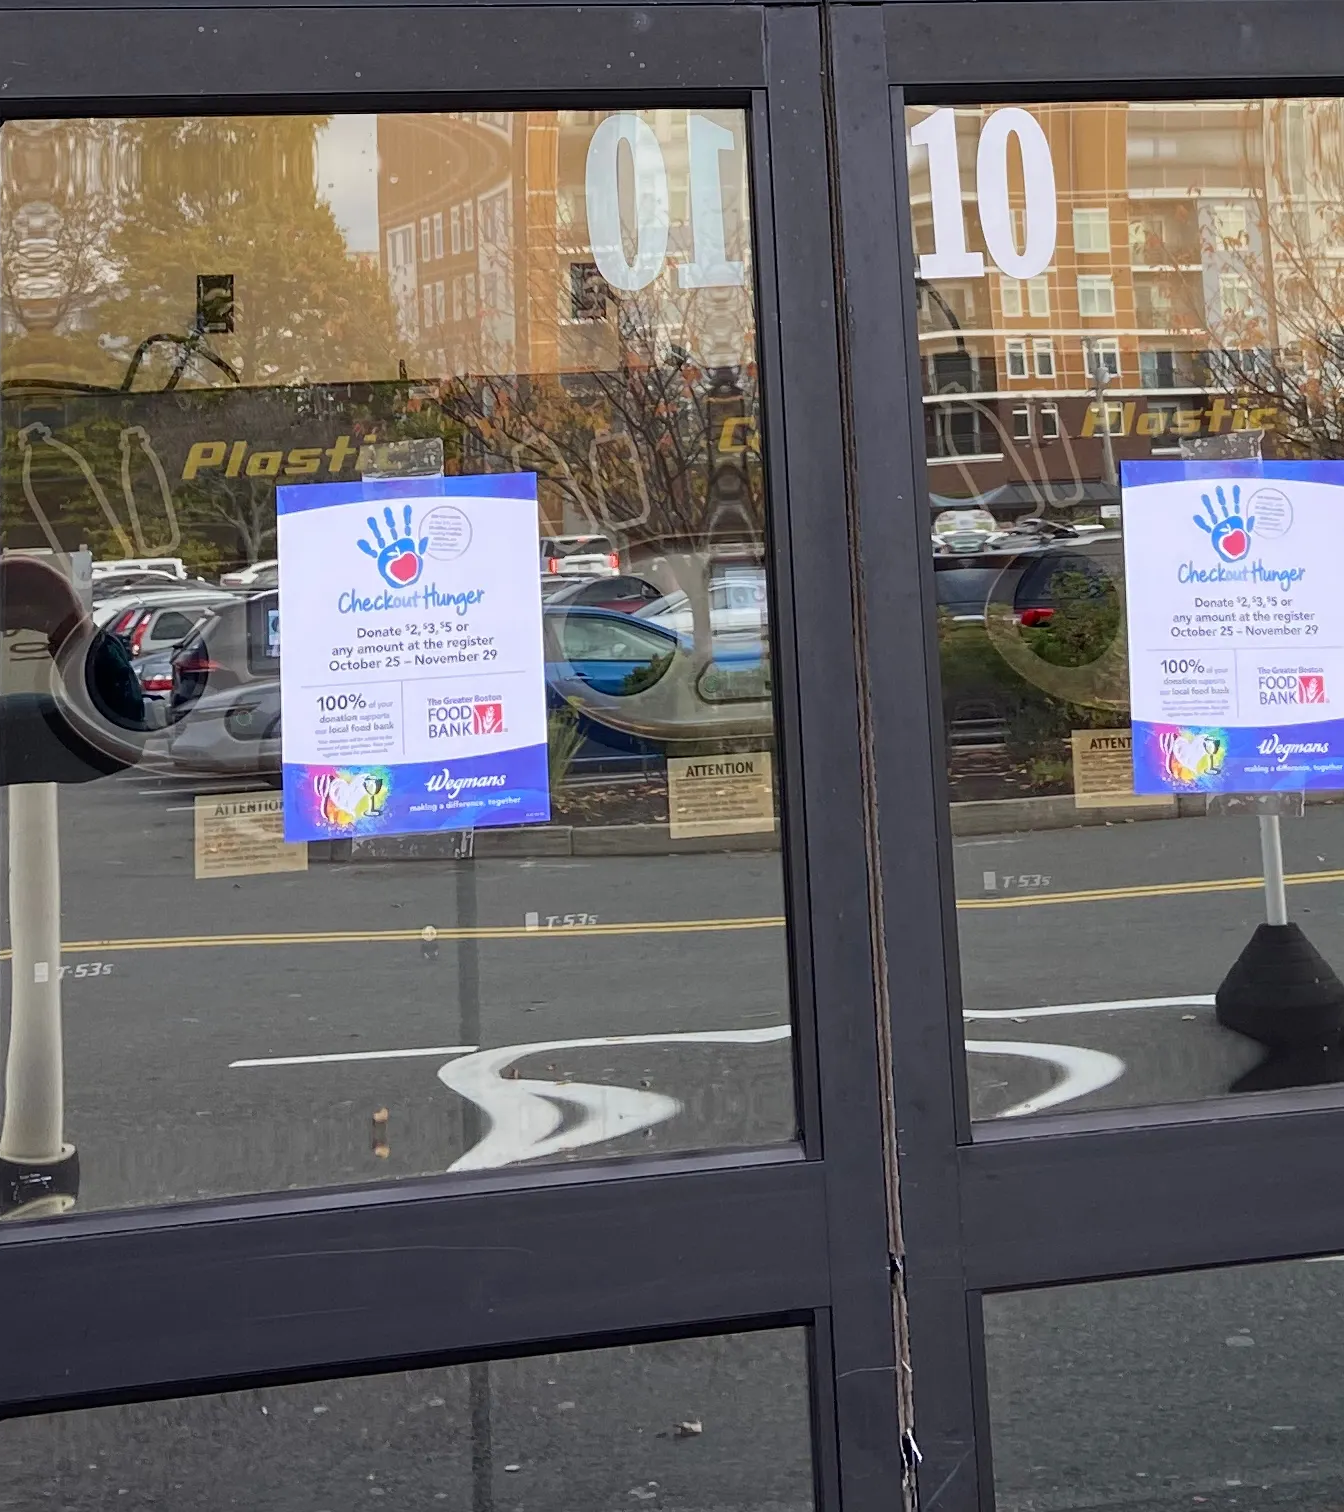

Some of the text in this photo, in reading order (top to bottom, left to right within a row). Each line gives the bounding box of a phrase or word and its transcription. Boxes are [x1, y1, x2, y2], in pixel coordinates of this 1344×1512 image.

[911, 107, 1056, 279] 10
[1081, 397, 1278, 437] Plastic
[1177, 558, 1306, 592] Checkout Hunger
[338, 582, 485, 616] Checkout Hunger
[1194, 597, 1234, 608] Donate
[1280, 598, 1293, 607] or
[1173, 611, 1315, 625] any amount at the register
[356, 626, 402, 638] Donate
[455, 622, 470, 632] or
[1170, 626, 1217, 637] October
[1220, 626, 1234, 636] 25
[1245, 625, 1302, 636] November
[1304, 624, 1319, 635] 29
[331, 636, 494, 658] any amount at the register
[329, 658, 382, 672] October
[385, 656, 400, 668] 25
[414, 651, 480, 666] November
[482, 649, 498, 661] 29
[1160, 658, 1205, 674] 100%
[1258, 675, 1297, 690] FOOD
[316, 692, 367, 712] 100%
[427, 694, 502, 706] The Greater Boston
[1259, 691, 1298, 705] BANK
[428, 705, 472, 722] FOOD
[328, 724, 349, 734] local
[351, 722, 371, 732] food
[373, 720, 394, 730] bank
[428, 721, 473, 739] BANK
[1090, 737, 1132, 750] ATTENT
[1256, 733, 1329, 763] Wegmans
[686, 761, 754, 777] ATTENTION
[423, 768, 507, 799] Wegmans
